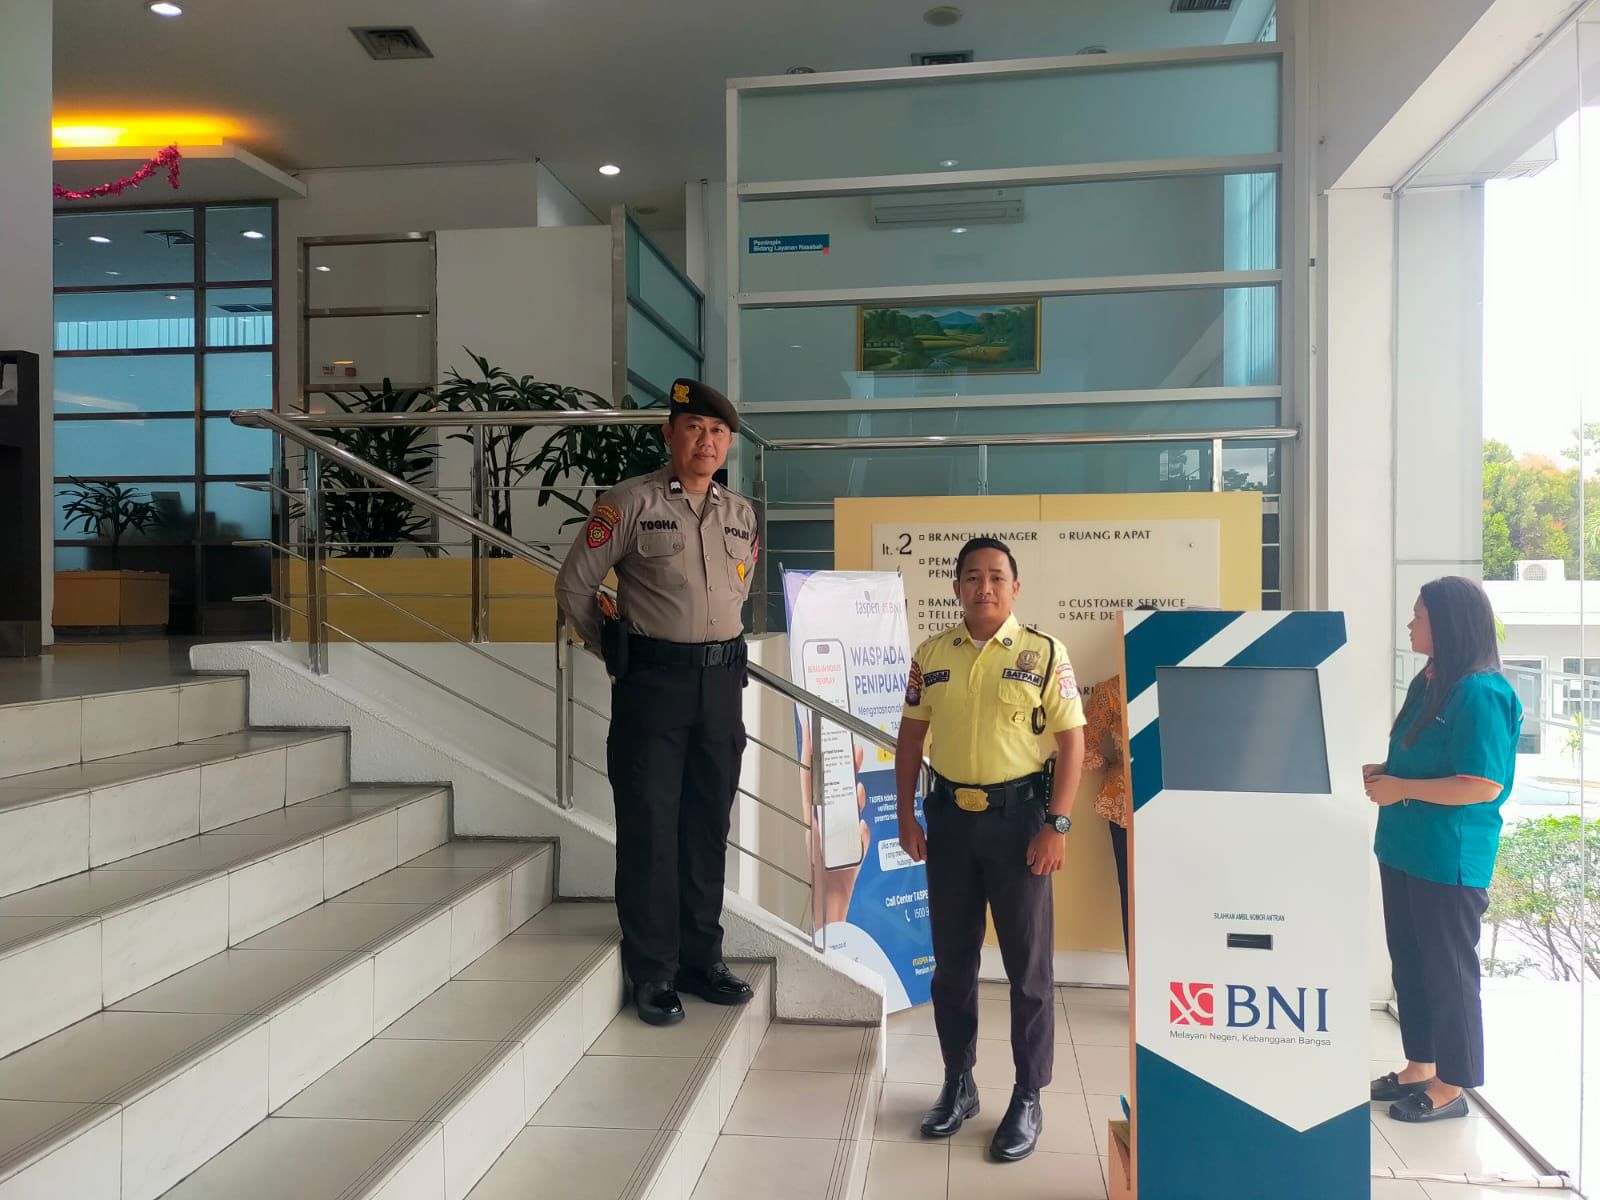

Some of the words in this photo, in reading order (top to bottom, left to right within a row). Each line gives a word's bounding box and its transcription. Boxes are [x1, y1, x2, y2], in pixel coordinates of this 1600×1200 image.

[775, 245, 798, 253] Layanan
[640, 520, 678, 531] YOGHA
[724, 526, 749, 541] POLRI
[928, 532, 976, 542] BRANCH
[981, 531, 1038, 541] MANAGER
[1069, 531, 1110, 541] RUANG
[1114, 530, 1152, 540] RAPAT
[898, 532, 913, 555] 2
[928, 557, 958, 566] PEMA
[856, 600, 880, 617] taspen
[928, 598, 962, 607] BANKI
[1069, 598, 1133, 608] CUSTOMER
[1138, 598, 1186, 607] SERVICE
[928, 610, 965, 620] TELLER
[1069, 611, 1095, 621] SAFE
[1100, 611, 1115, 620] DE
[850, 645, 906, 667] WASPADA
[854, 672, 907, 695] PENIPUAN
[1006, 670, 1040, 684] SATPAM
[858, 703, 903, 718] Mengatasnamak
[885, 896, 896, 908] Call
[896, 893, 913, 905] Center
[1225, 984, 1329, 1033] BNI
[1169, 1030, 1207, 1041] Melayani
[1210, 1032, 1240, 1043] Negeri,
[1242, 1034, 1296, 1046] Kebanggaan
[1298, 1036, 1331, 1047] Bangsa
